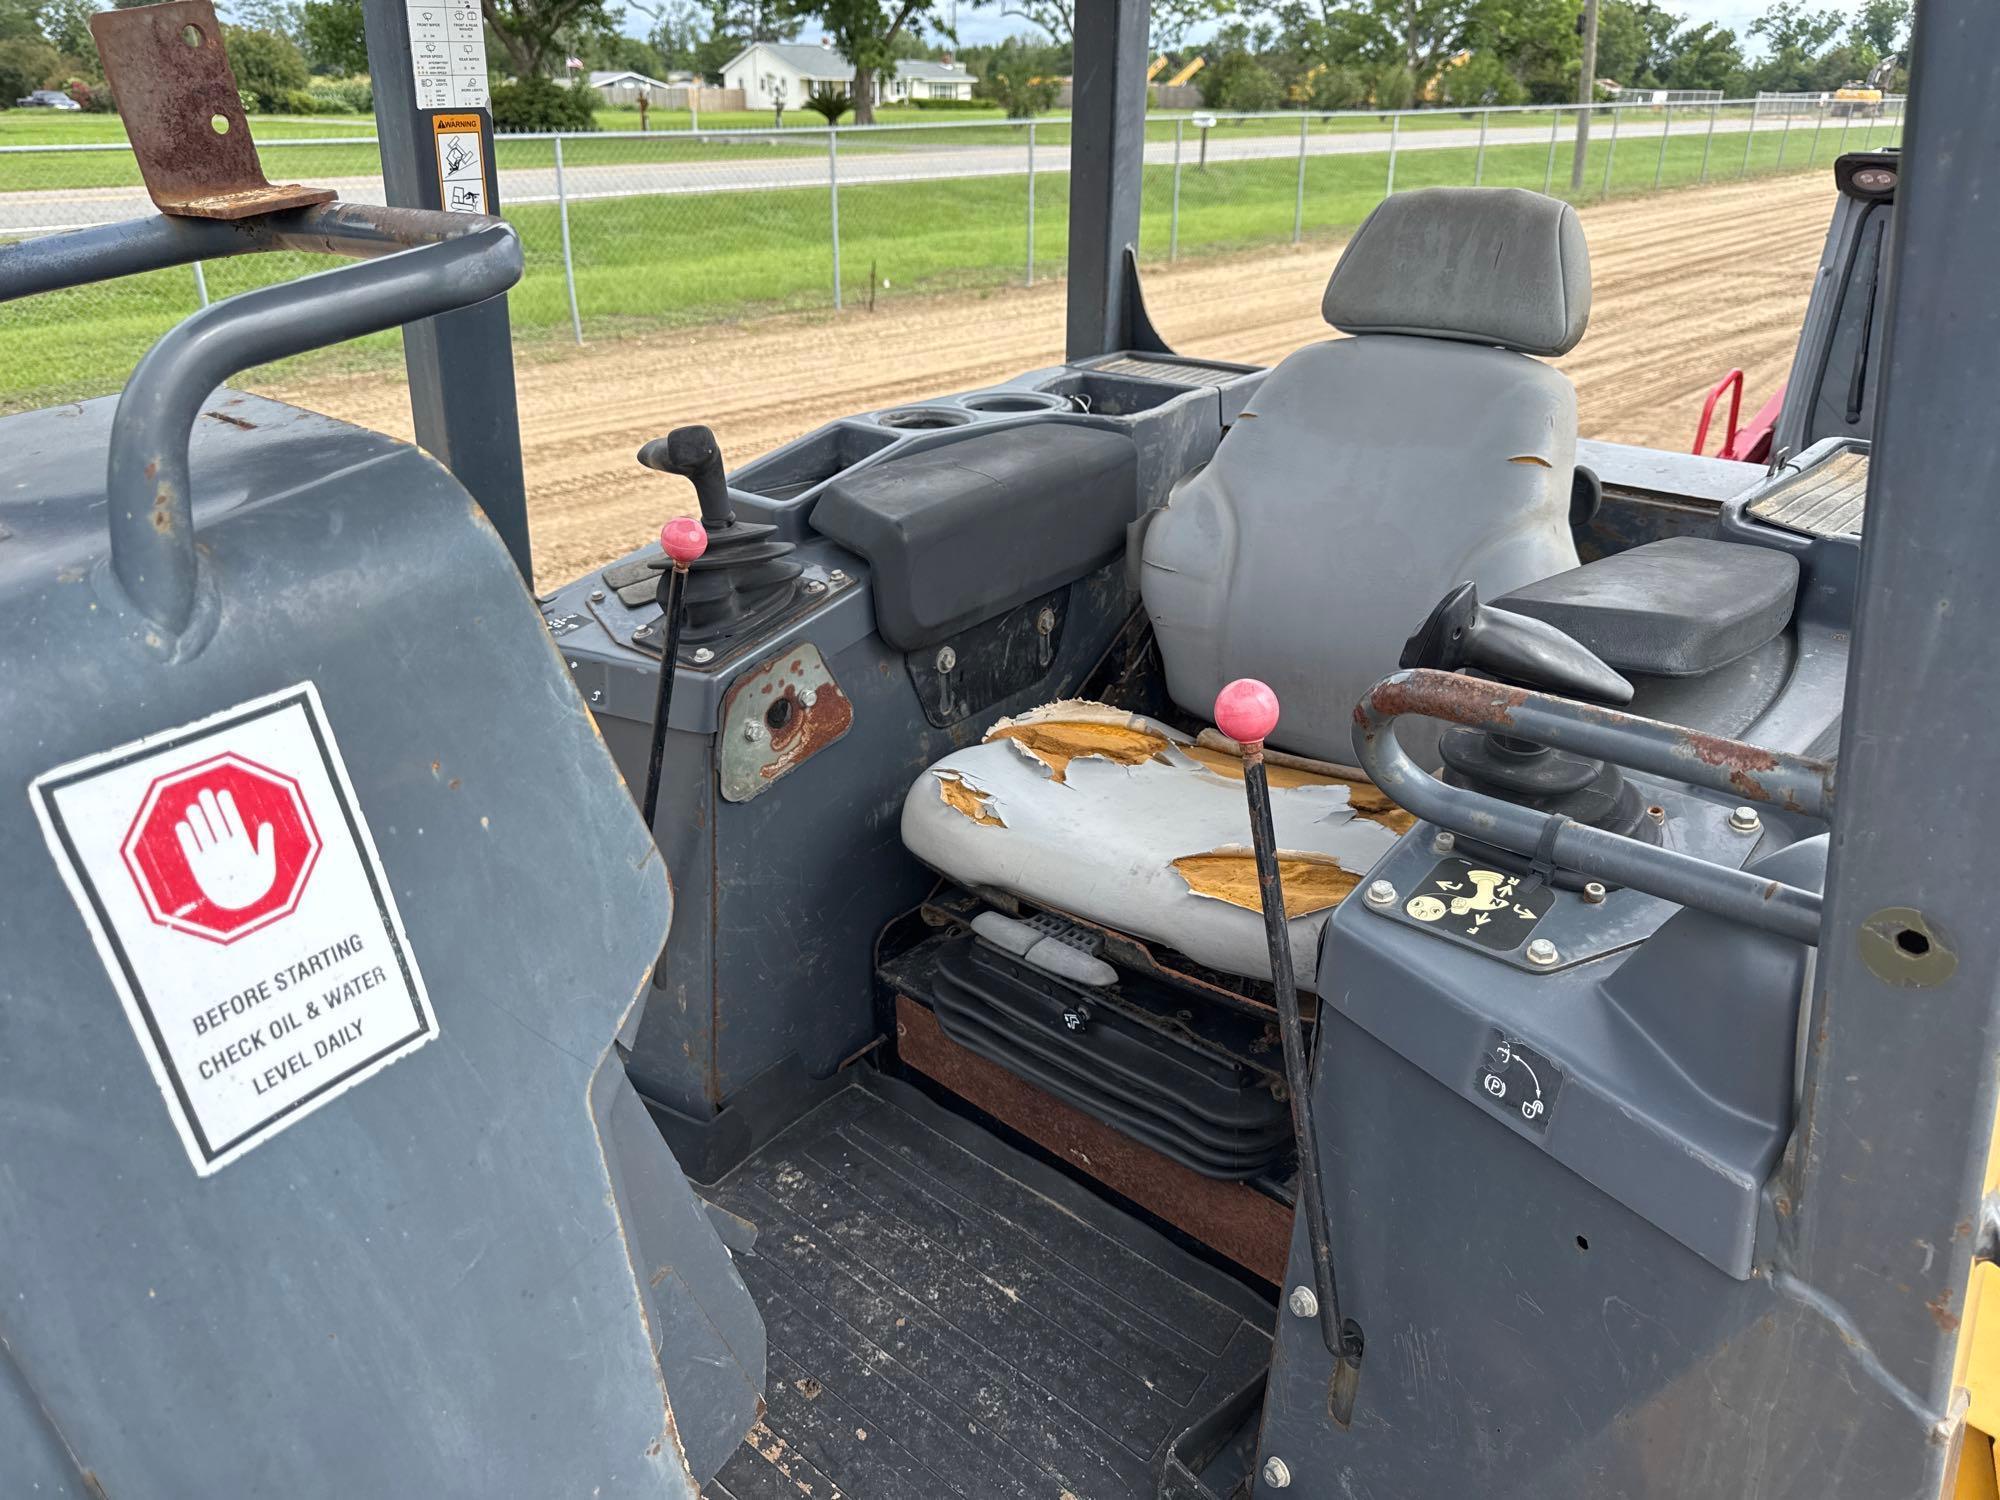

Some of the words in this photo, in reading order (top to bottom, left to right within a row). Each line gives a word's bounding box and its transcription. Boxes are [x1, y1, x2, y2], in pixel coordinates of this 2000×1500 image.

[193, 980, 272, 1036] BEFORE
[274, 934, 364, 991] STARTING
[199, 1029, 267, 1080] CHECK
[269, 1012, 303, 1039] OIL
[306, 1001, 321, 1020] &
[322, 966, 387, 1009] WATER
[252, 1051, 313, 1095] LEVEL
[314, 1018, 363, 1059] DAILY
[1491, 1079, 1501, 1091] P
